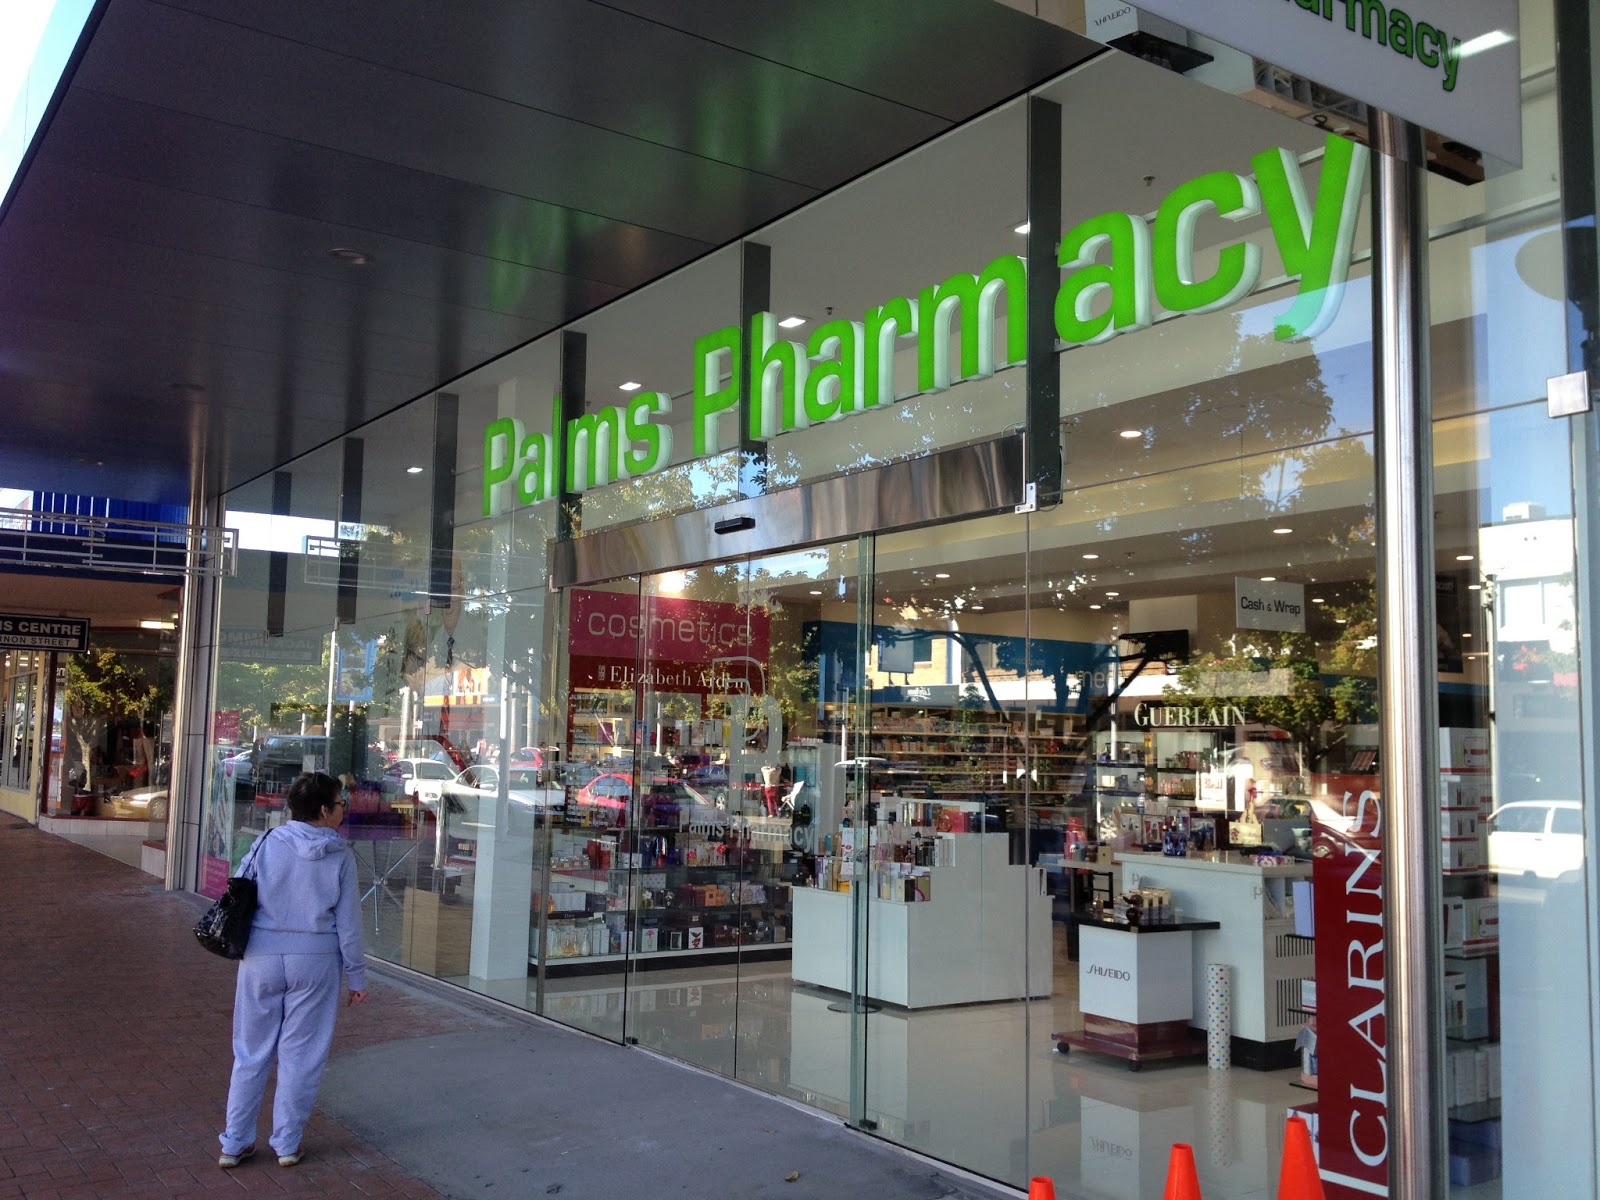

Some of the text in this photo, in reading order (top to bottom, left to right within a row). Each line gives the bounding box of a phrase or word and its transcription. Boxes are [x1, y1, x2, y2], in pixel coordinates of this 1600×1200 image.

[482, 134, 1369, 517] Palms Pharmacy
[1240, 596, 1265, 611] Cash
[1274, 600, 1301, 617] Wrap
[18, 621, 81, 636] CENTRE
[588, 612, 753, 646] cosmetics
[30, 637, 70, 647] STREET
[610, 665, 745, 689] Elizabeth Arden
[1134, 702, 1250, 727] GUERLAIN
[1343, 788, 1389, 1167] CLARINS
